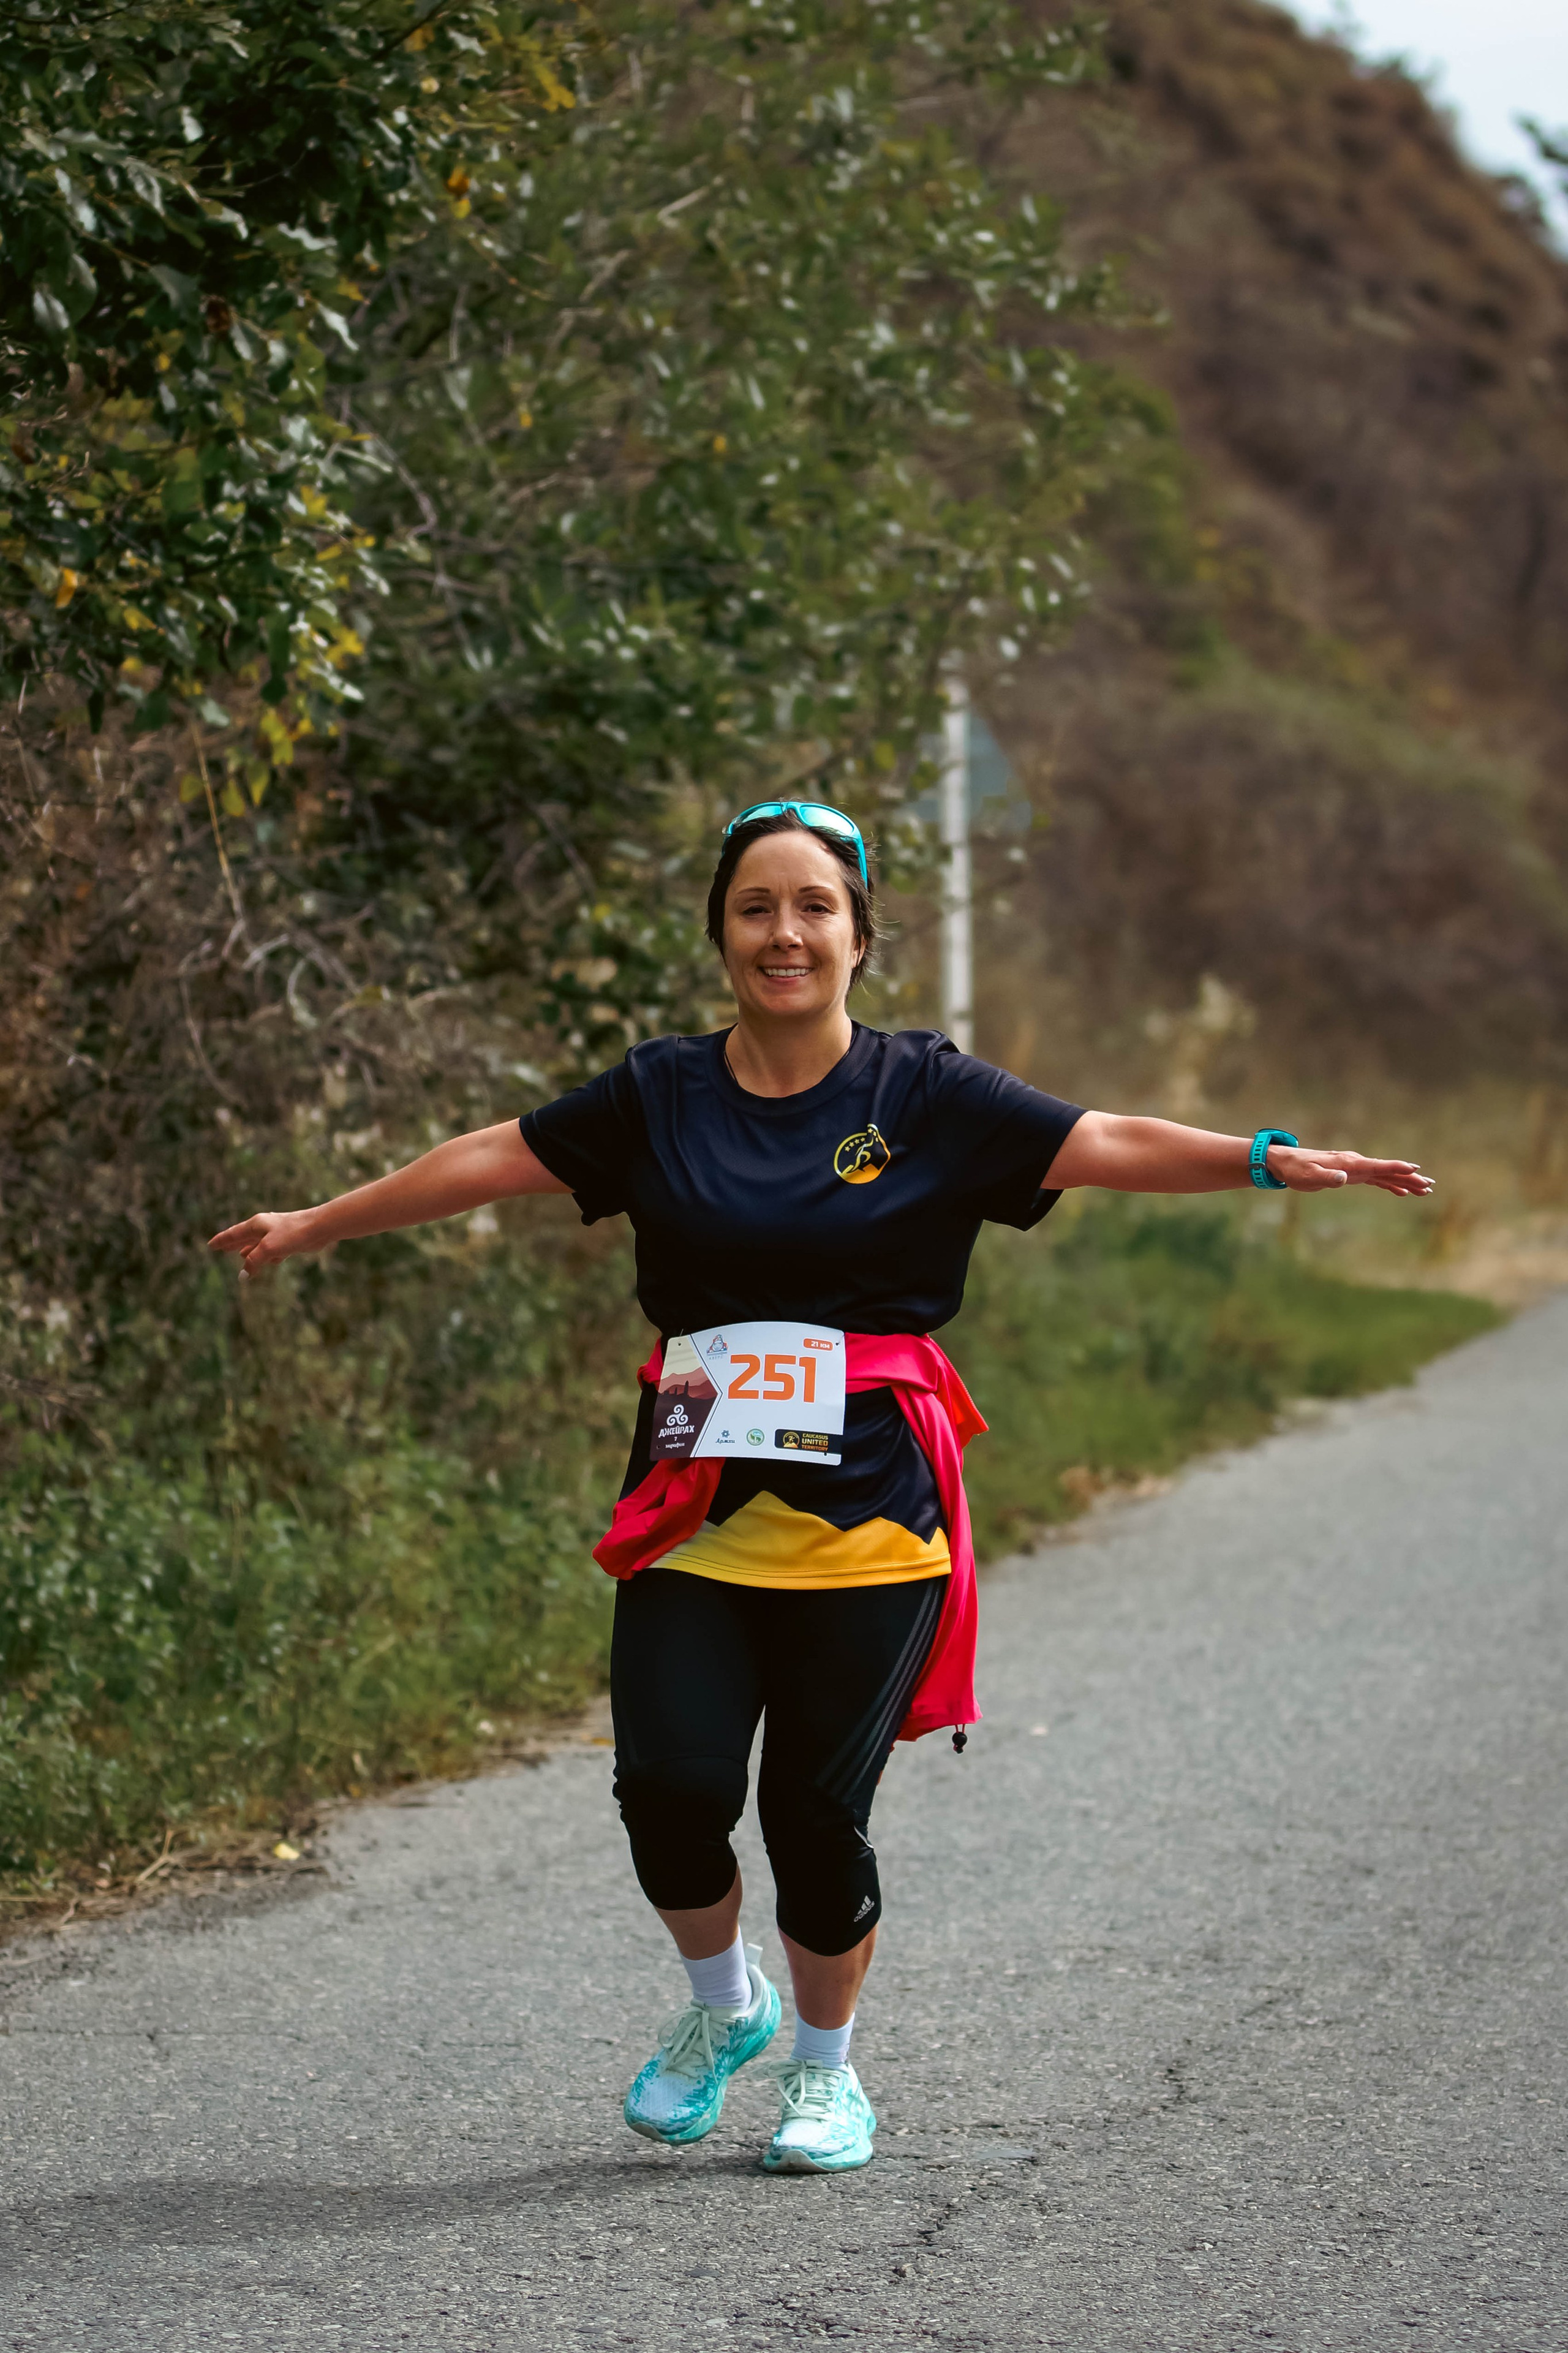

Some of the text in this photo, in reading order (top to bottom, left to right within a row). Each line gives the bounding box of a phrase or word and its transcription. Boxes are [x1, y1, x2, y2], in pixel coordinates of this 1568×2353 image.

[728, 1354, 816, 1403] 251
[658, 1425, 695, 1438] ДЖЕЙРАХ
[854, 1901, 875, 1922] adidas
